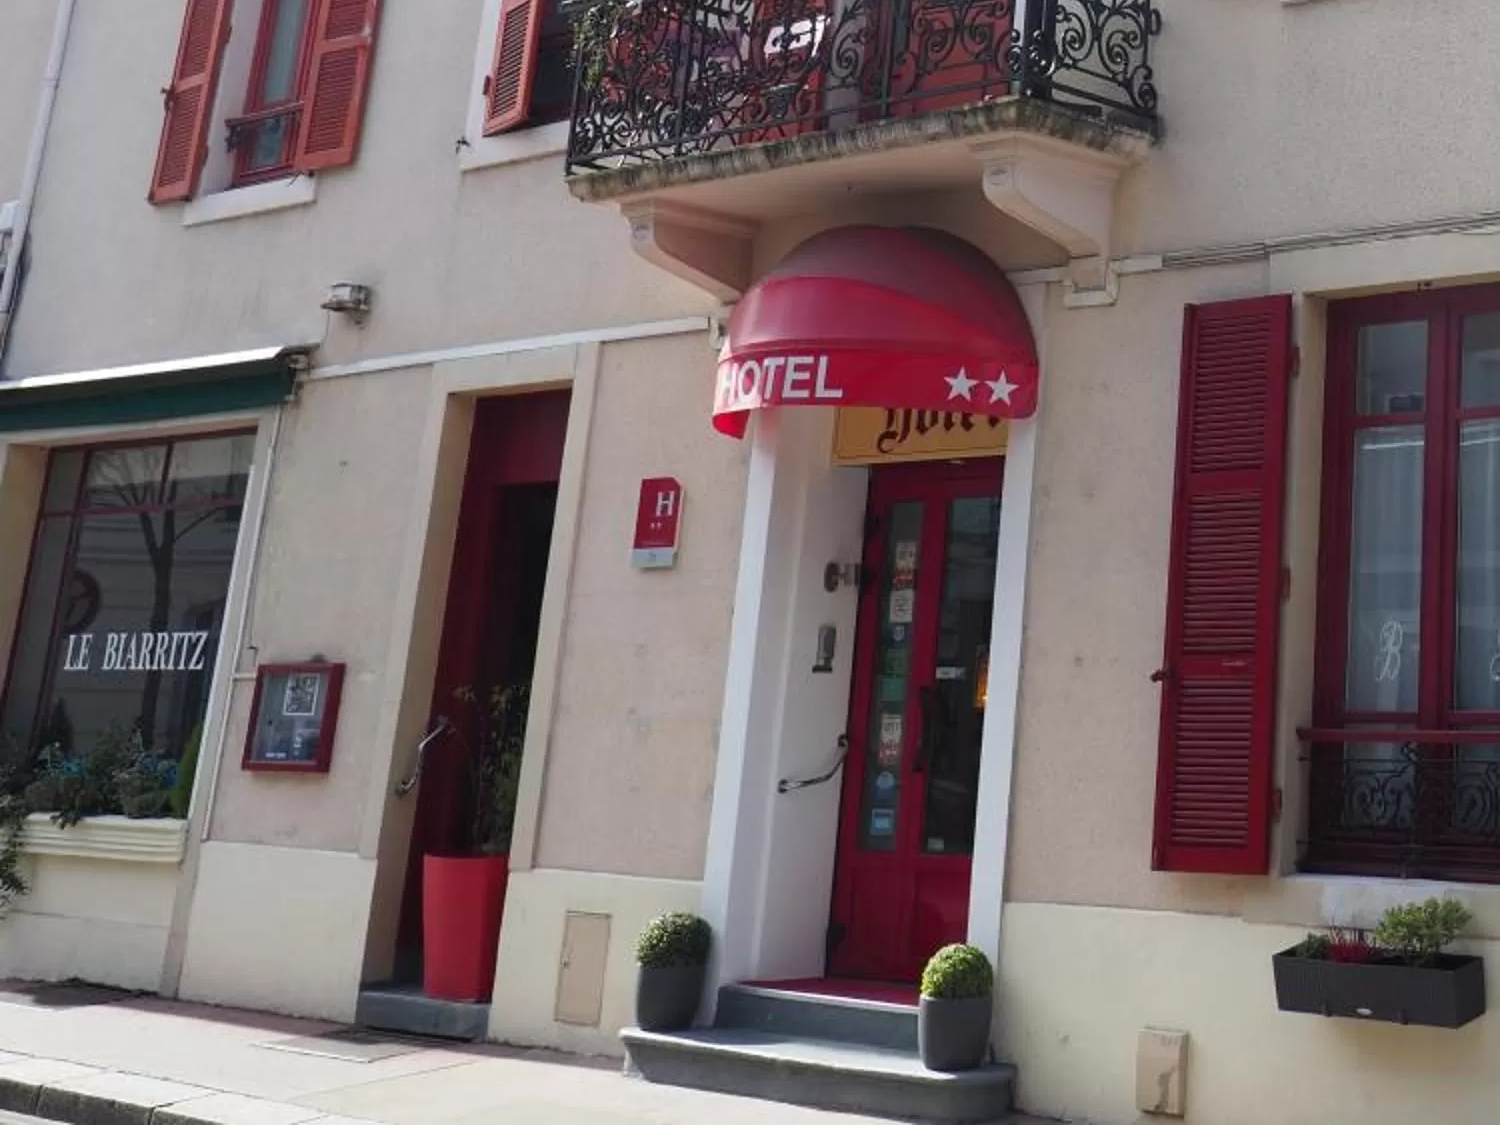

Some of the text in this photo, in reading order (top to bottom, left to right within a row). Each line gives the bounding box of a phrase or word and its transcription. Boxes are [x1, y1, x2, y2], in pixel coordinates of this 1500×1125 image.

[716, 355, 843, 410] HOTEL
[656, 491, 675, 516] H
[64, 631, 208, 671] LE BIARRITZ
